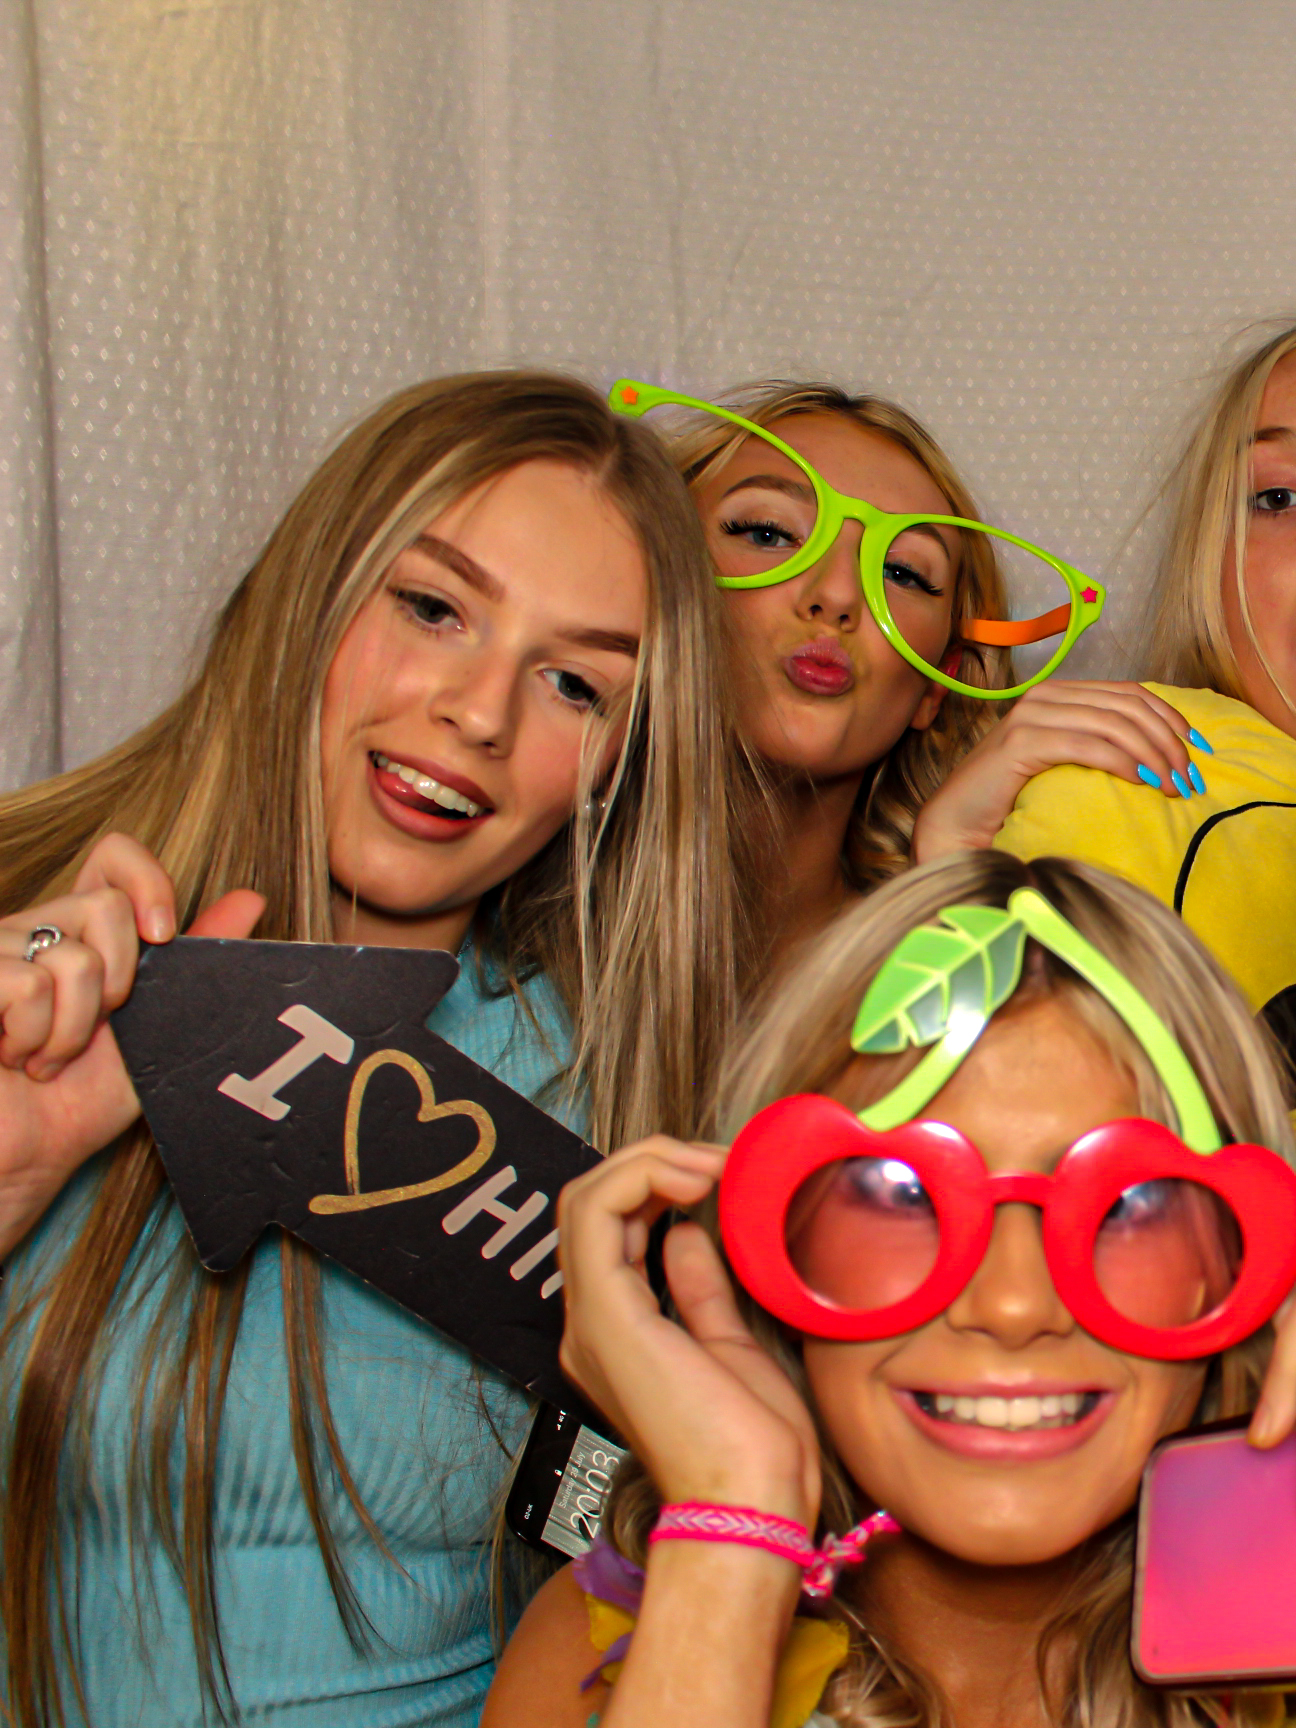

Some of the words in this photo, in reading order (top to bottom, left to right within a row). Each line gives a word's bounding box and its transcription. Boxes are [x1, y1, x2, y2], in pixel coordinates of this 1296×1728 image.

[218, 1004, 355, 1121] I
[559, 1478, 576, 1508] Saturday
[570, 1466, 579, 1478] 29
[575, 1451, 585, 1467] July
